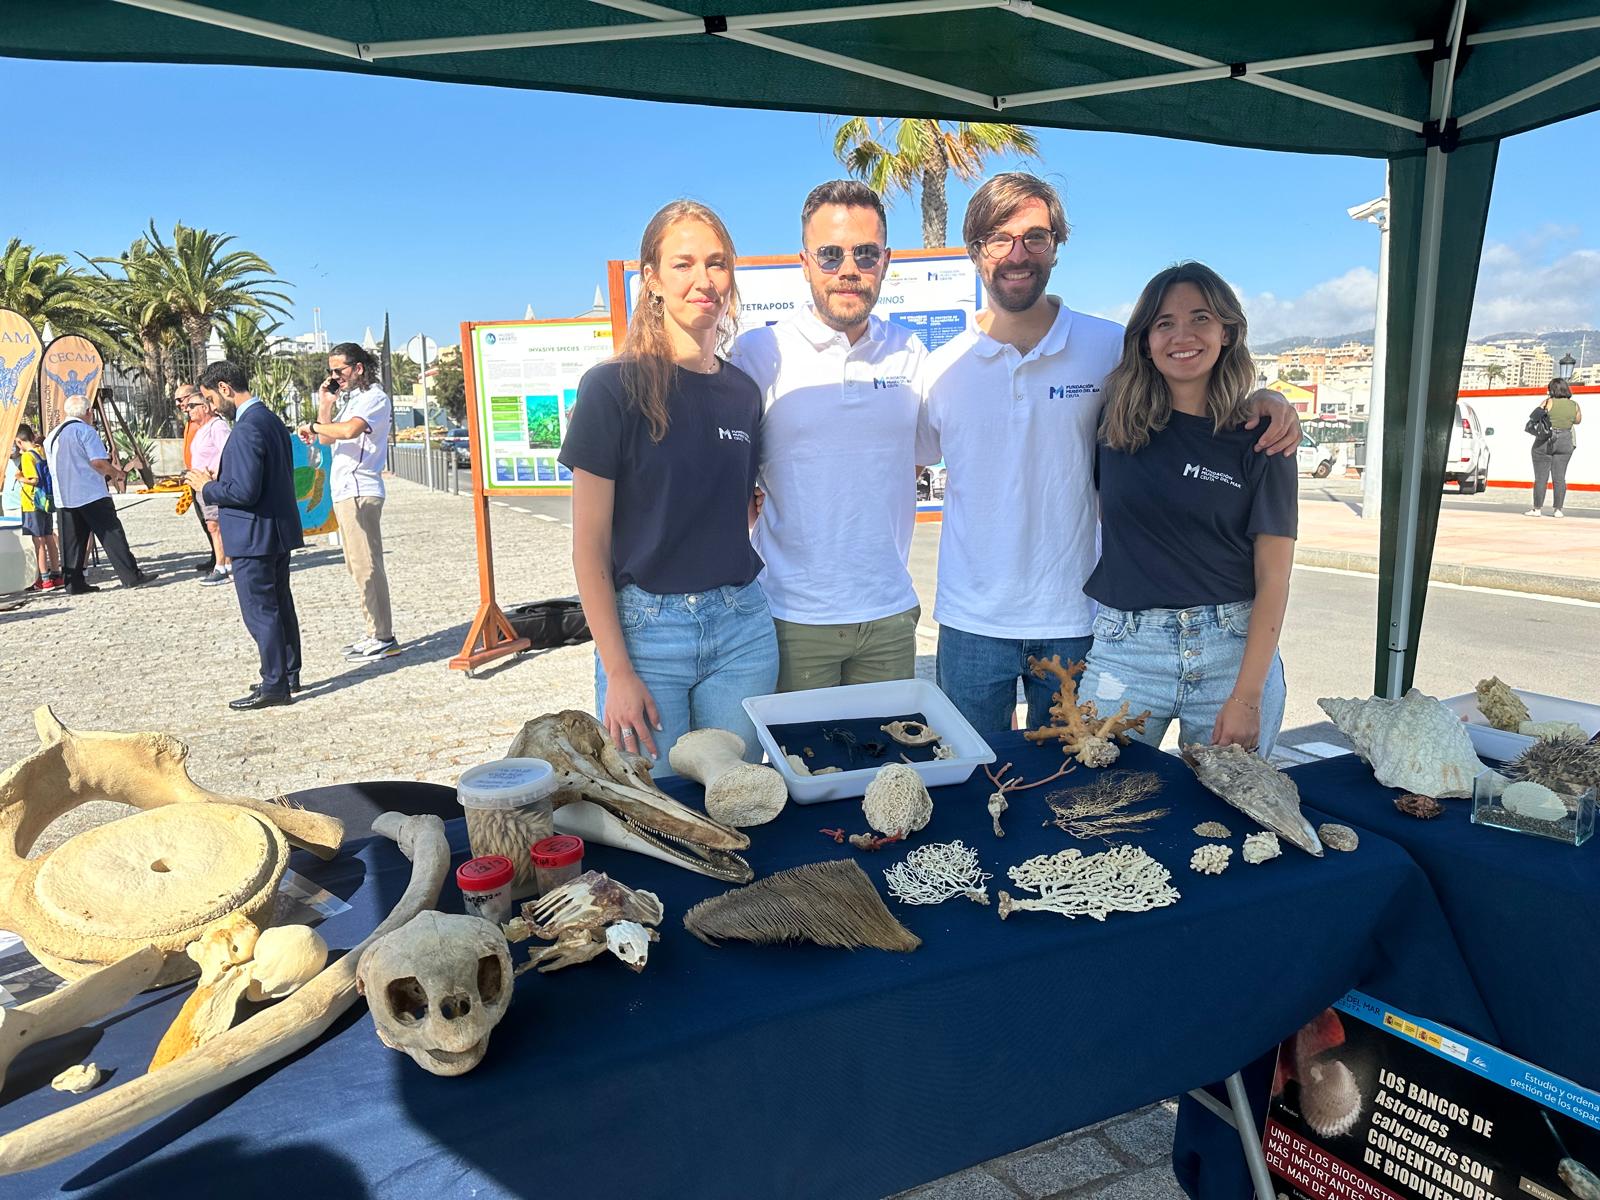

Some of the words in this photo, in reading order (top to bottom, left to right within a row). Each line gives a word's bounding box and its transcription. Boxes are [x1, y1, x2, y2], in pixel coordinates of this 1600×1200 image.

[742, 301, 795, 311] TETRAPODS
[48, 352, 96, 364] CECAM
[1363, 1001, 1381, 1015] MAR
[1378, 1068, 1406, 1094] LOS
[1407, 1082, 1470, 1126] BANCOS
[1471, 1114, 1494, 1139] DE
[1510, 1079, 1543, 1098] gestión
[1544, 1093, 1557, 1103] de
[1557, 1098, 1571, 1110] los
[1572, 1106, 1600, 1125] espac
[1525, 1072, 1558, 1093] Estudio
[1558, 1088, 1566, 1097] y
[1374, 1089, 1450, 1138] Astroides
[1268, 1138, 1289, 1159] MÁS
[1291, 1154, 1365, 1200] IMPORTANTES
[1292, 1136, 1306, 1154] DE
[1308, 1144, 1329, 1168] LOS
[1364, 1147, 1382, 1170] DE
[1367, 1128, 1503, 1200] CONCENTRADORE
[1371, 1111, 1459, 1166] calycularis
[1459, 1155, 1494, 1186] SON
[1266, 1152, 1285, 1172] DEL
[1287, 1164, 1309, 1187] MAR
[1311, 1179, 1326, 1197] DE
